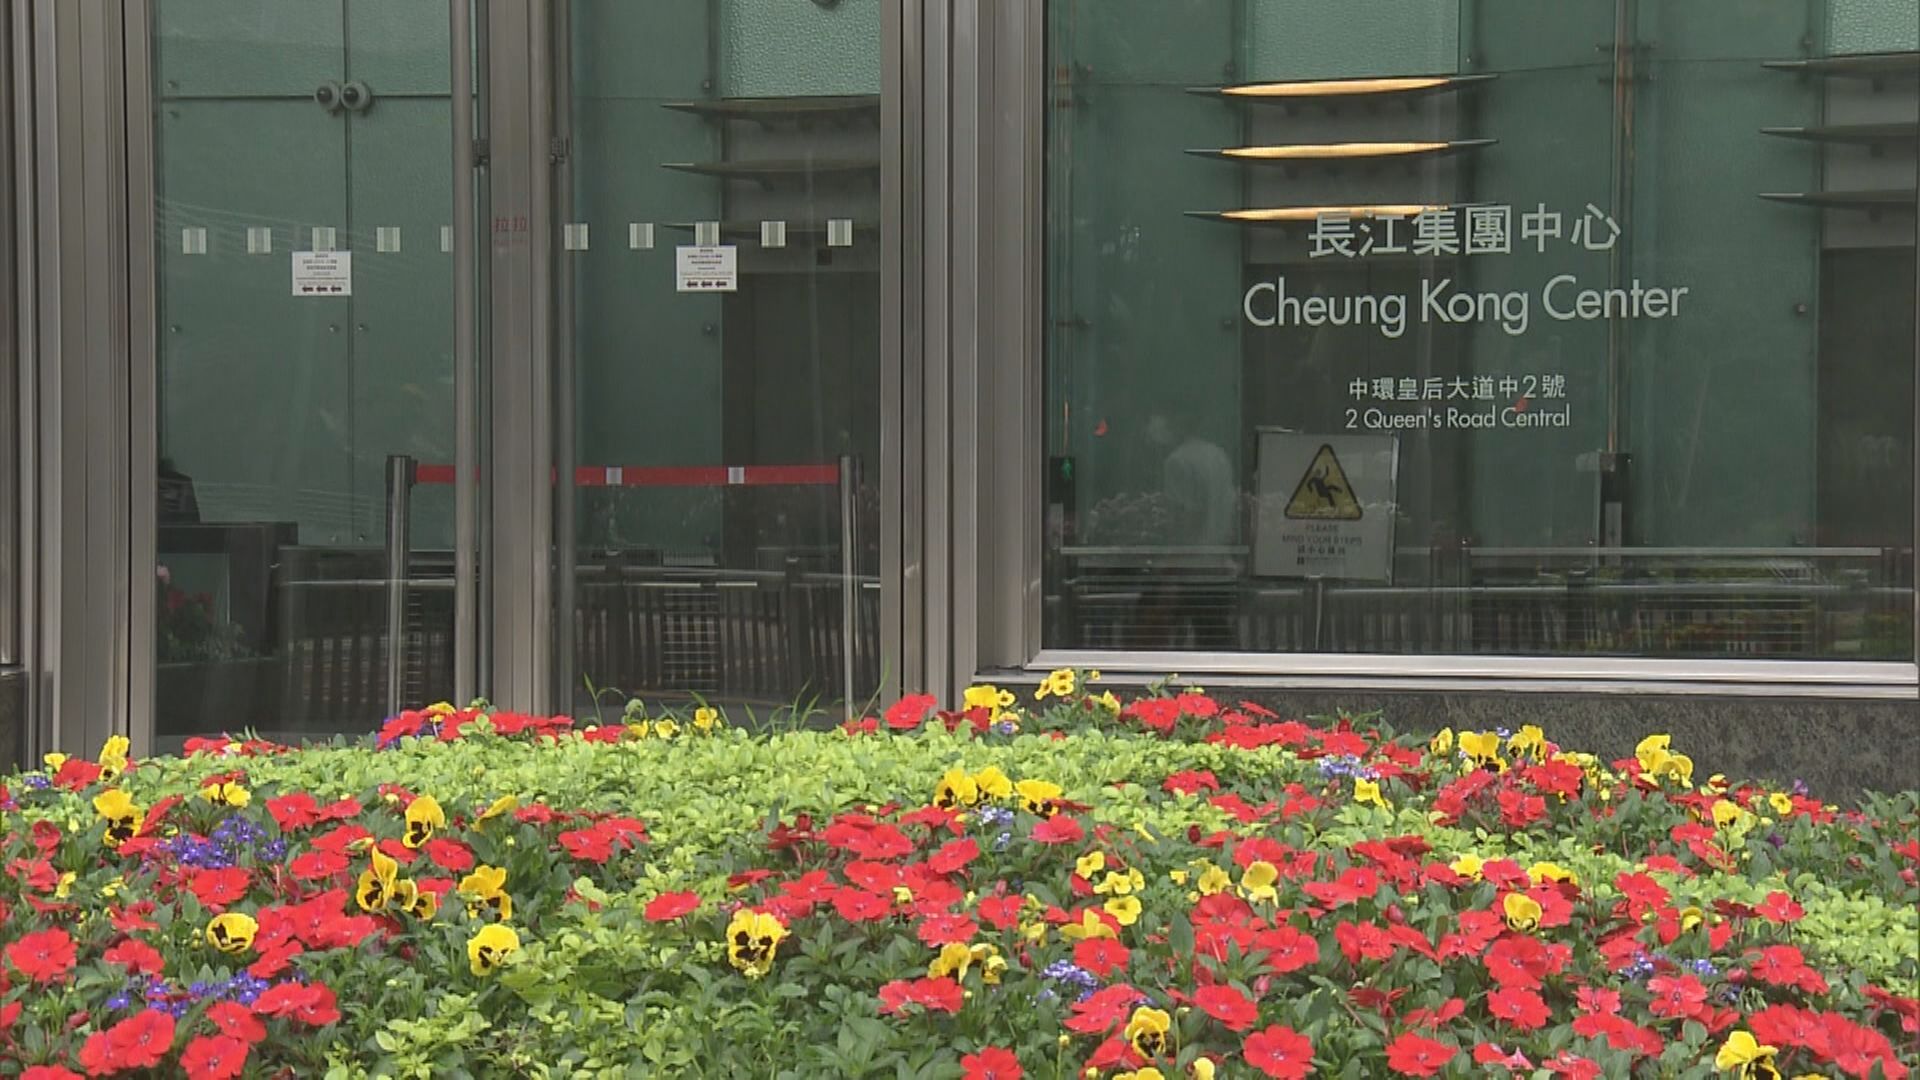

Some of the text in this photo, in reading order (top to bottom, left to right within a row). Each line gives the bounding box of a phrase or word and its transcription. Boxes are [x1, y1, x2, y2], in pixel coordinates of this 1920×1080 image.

[1308, 202, 1621, 258] 長江集團中心
[1244, 274, 1689, 338] Cheung Kong Center
[1349, 374, 1566, 400] 中環皇后大道中2號
[1345, 402, 1570, 429] 2 Queen's Road Central
